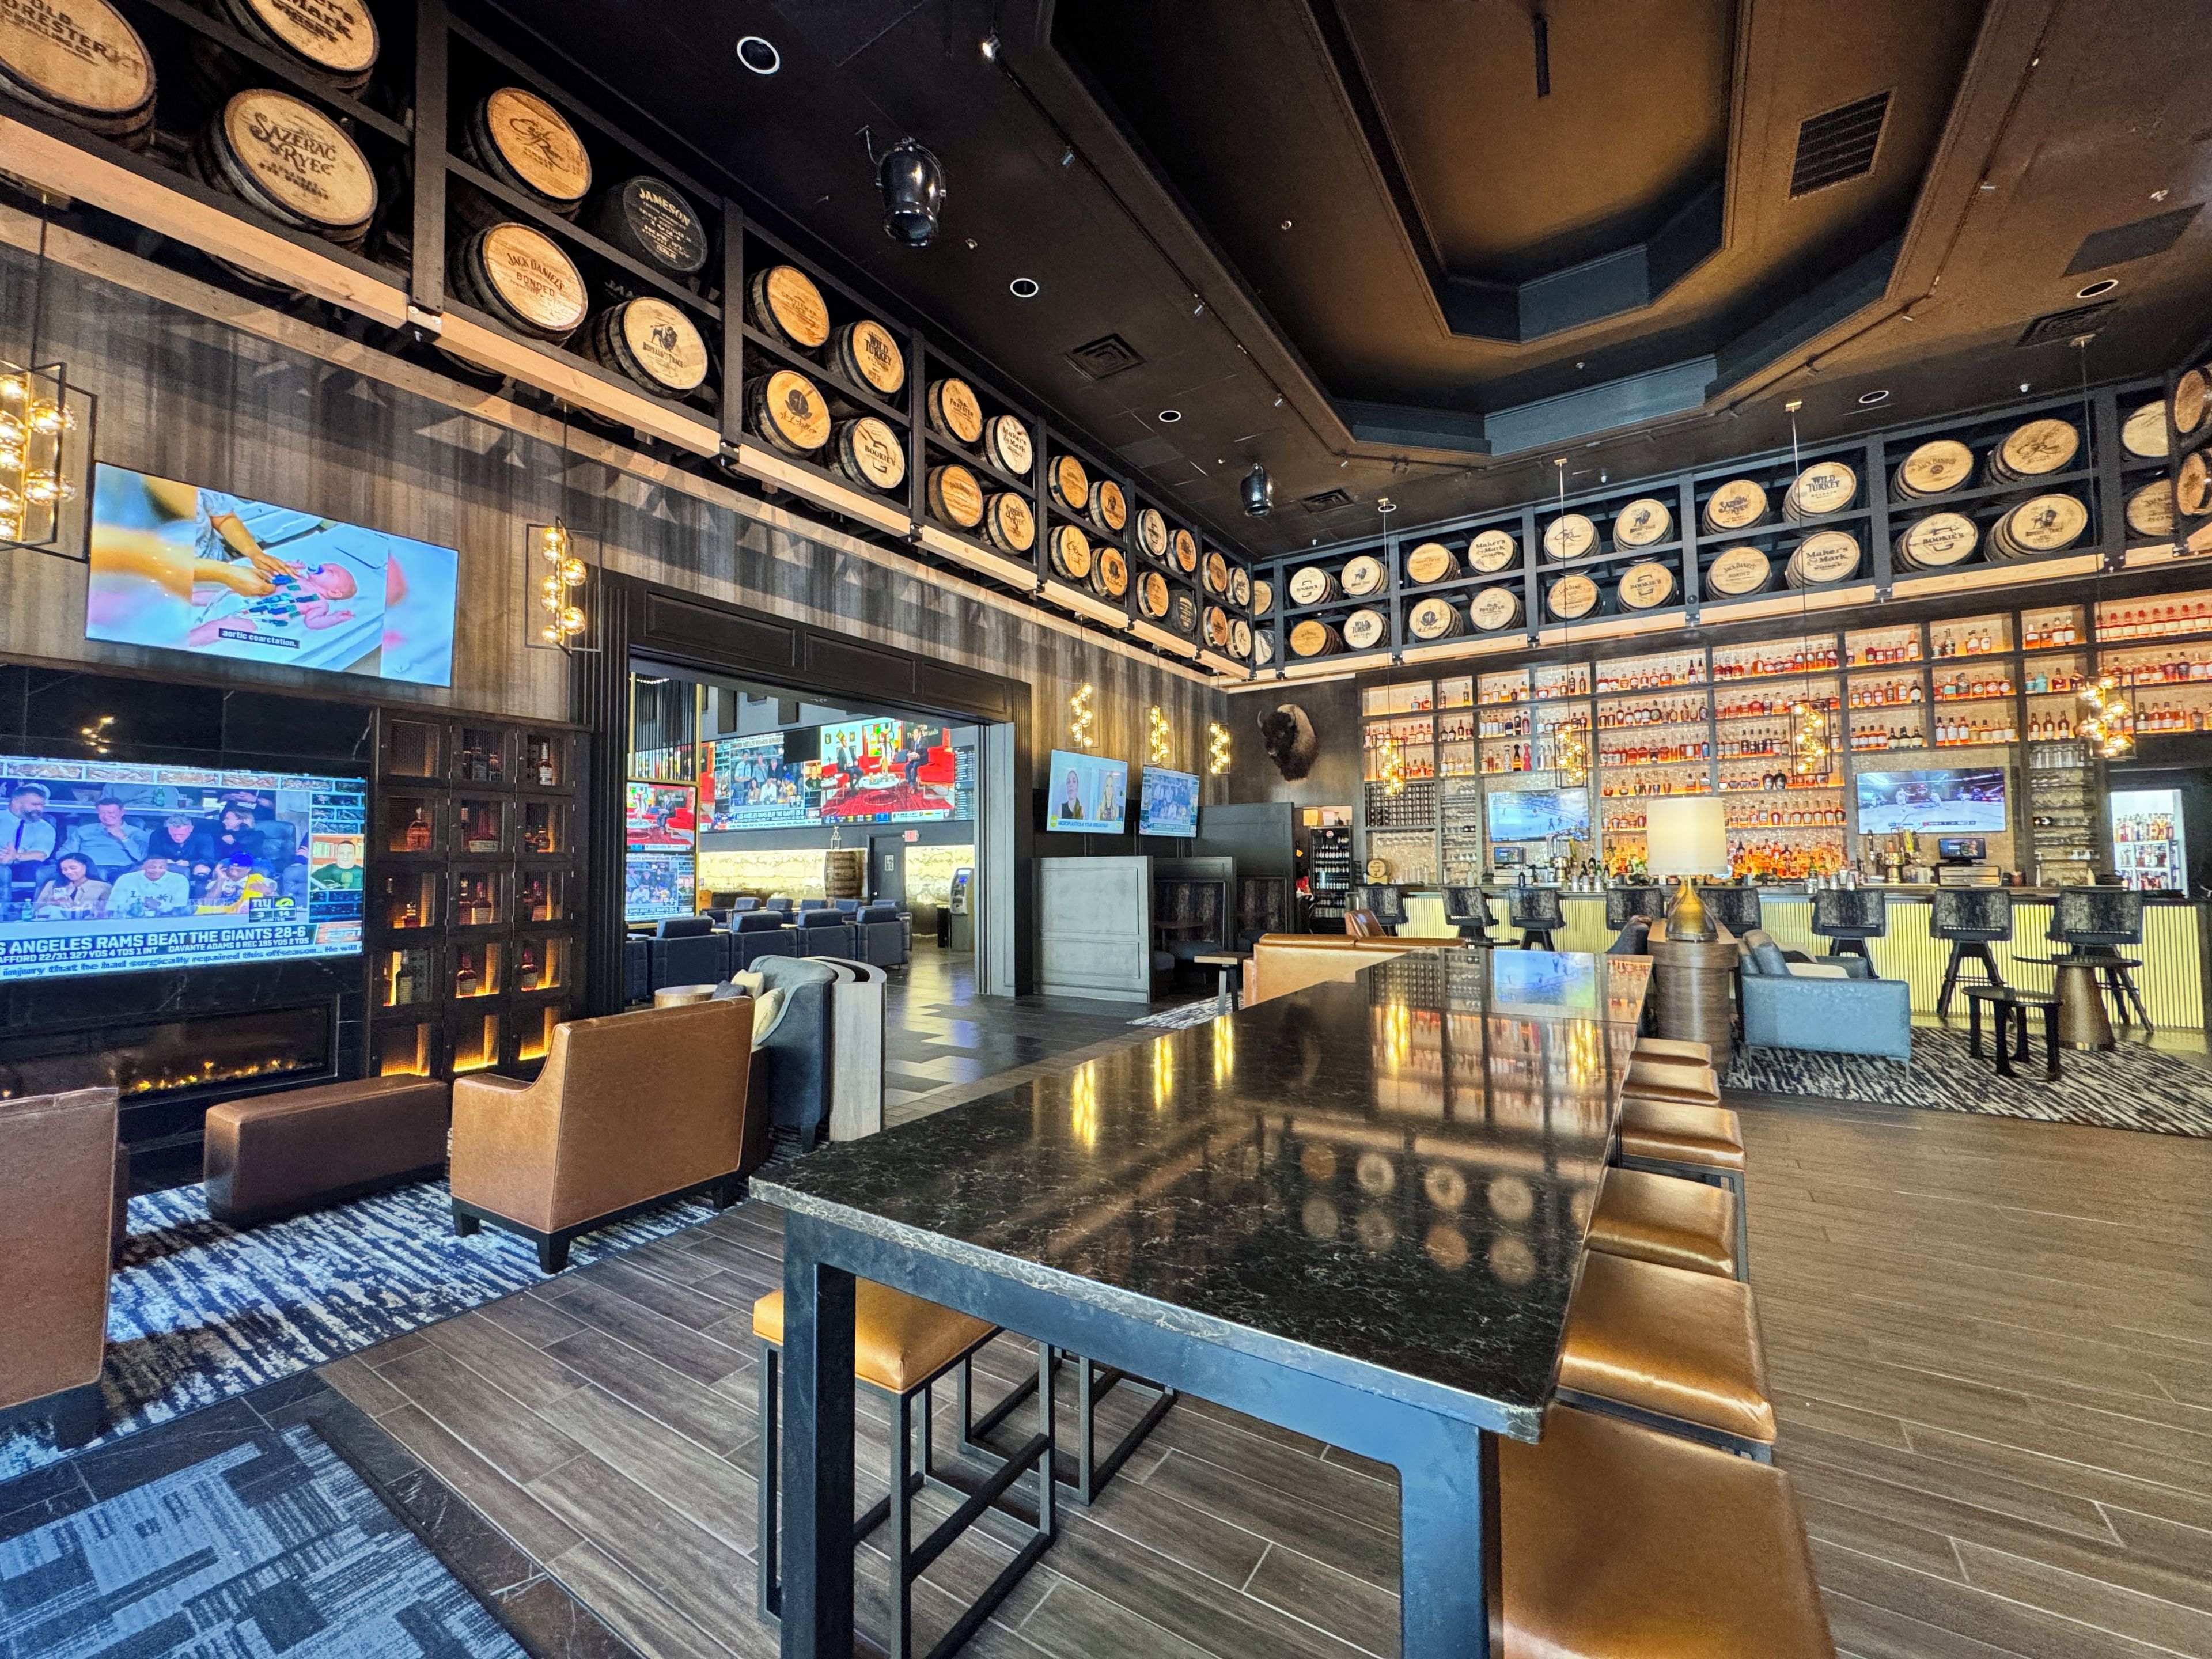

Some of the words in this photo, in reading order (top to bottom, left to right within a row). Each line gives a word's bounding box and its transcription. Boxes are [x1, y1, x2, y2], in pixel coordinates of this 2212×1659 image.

[31, 0, 73, 25] OLD
[3, 0, 108, 59] ORESTER
[249, 112, 337, 161] SAZERAC
[276, 142, 335, 175] RYE
[639, 188, 691, 226] JAMESON
[507, 253, 529, 268] JACK
[530, 259, 565, 290] DANIEL'S
[516, 271, 555, 297] BONDED
[865, 338, 892, 366] TURKEY
[869, 332, 888, 354] WILD
[950, 398, 974, 417] FORESTER
[1003, 426, 1027, 446] Maker's
[1010, 439, 1026, 454] Mark
[1806, 480, 1840, 493] TURKEY
[1811, 475, 1835, 485] WILD
[1475, 539, 1506, 549] Maker's
[1922, 533, 1965, 545] BOOKIE'S
[1806, 547, 1849, 559] Maker's
[1819, 554, 1849, 563] Mark
[1724, 564, 1736, 574] JACK
[1736, 562, 1756, 570] DANIEL'S
[1630, 579, 1662, 590] BOOKIE'S
[222, 630, 248, 640] aortic
[248, 634, 297, 647] coarctation.
[0, 954, 37, 964] AFFORD
[39, 952, 68, 961] 22/31
[70, 951, 88, 960] 327
[89, 950, 108, 959] YDS
[109, 949, 116, 957] 4
[117, 948, 135, 957] TDS
[143, 946, 158, 955] INT
[168, 944, 206, 953] DAVANTE
[206, 942, 235, 951] ADAMS
[243, 940, 258, 948] REC
[259, 939, 272, 947] 195
[295, 937, 309, 945] TDS
[9, 938, 93, 955] ANGELES
[97, 934, 144, 950] RAMS
[147, 932, 188, 946] BEAT
[189, 931, 218, 944] THE
[221, 927, 272, 941] GIANTS
[274, 926, 306, 940] 28-6
[3, 967, 46, 977] injury
[48, 964, 77, 973] that
[81, 963, 98, 971] he
[101, 960, 127, 969] had
[128, 956, 190, 968] surgically
[192, 952, 240, 963] repaired
[243, 950, 263, 959] this
[340, 944, 358, 952] will
